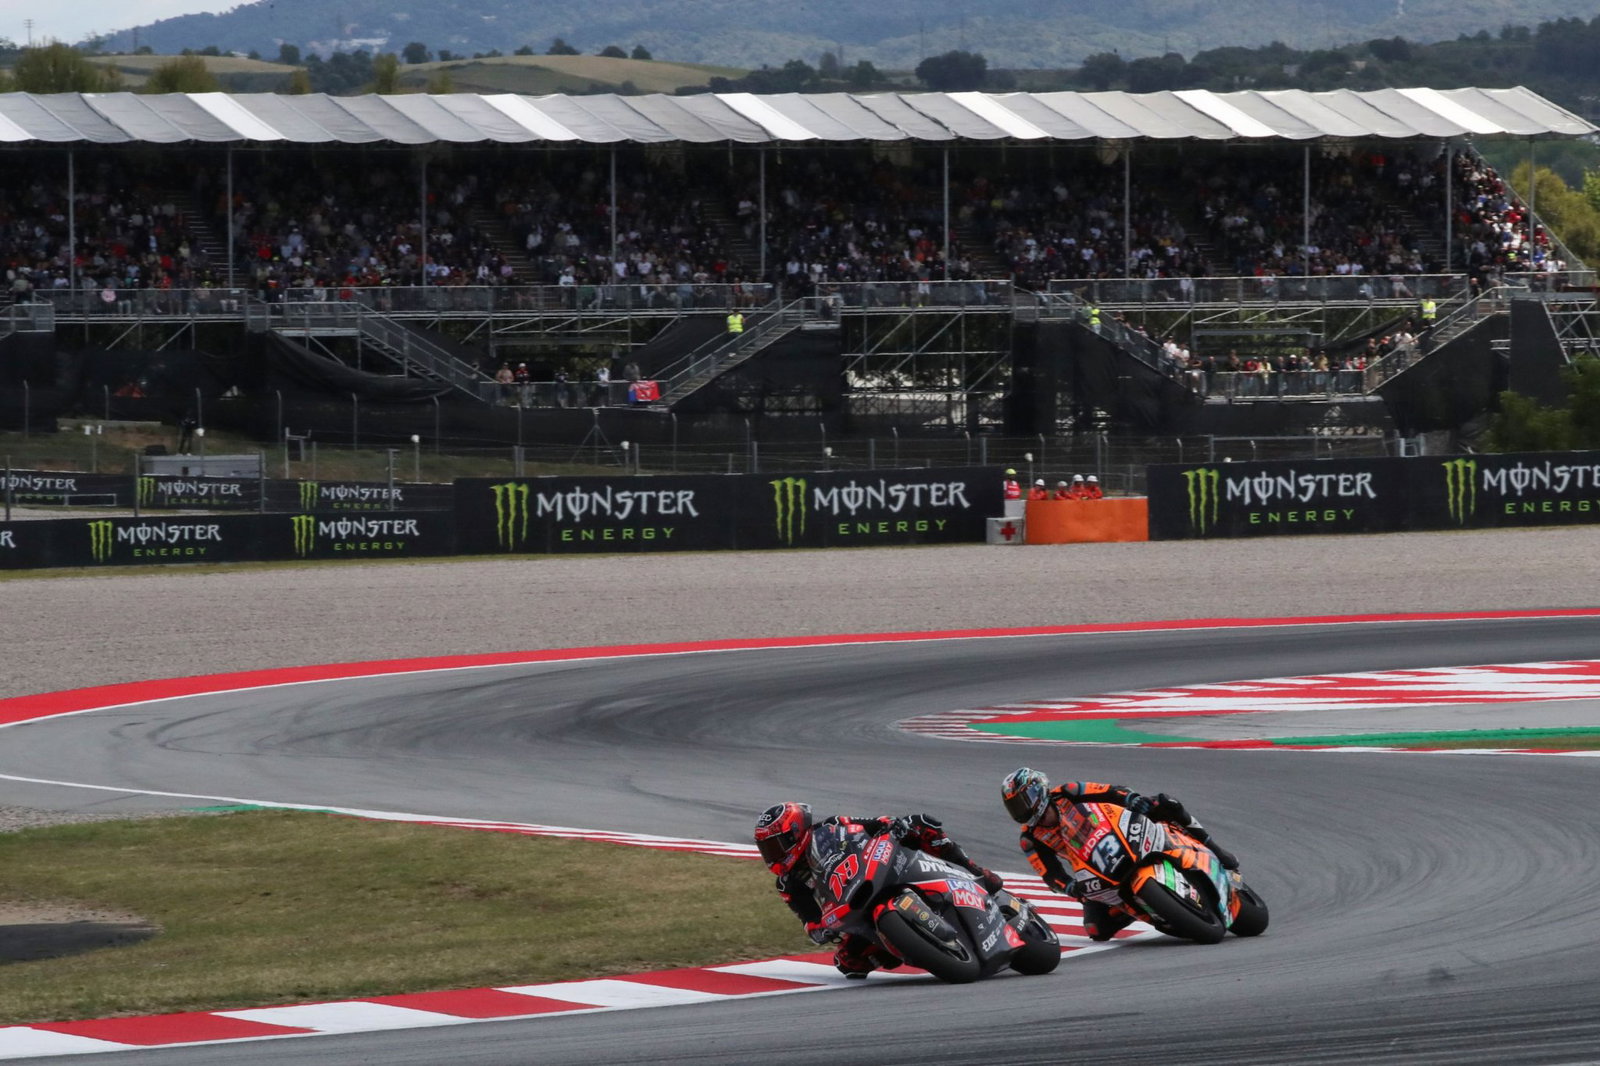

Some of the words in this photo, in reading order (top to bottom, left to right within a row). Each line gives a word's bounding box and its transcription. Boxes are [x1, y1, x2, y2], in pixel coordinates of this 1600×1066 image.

[157, 480, 242, 496] MONSTER
[320, 485, 404, 500] MONSTER
[1226, 470, 1377, 506] MONSTER
[536, 485, 699, 522] MONSTER
[812, 479, 971, 516] MONSTER
[1505, 500, 1600, 514] ENERG
[1250, 509, 1354, 524] ENERGY
[117, 522, 222, 545] MONSTER
[320, 517, 420, 539] MONSTER
[561, 527, 674, 541] ENERGY
[838, 519, 947, 535] ENERGY
[133, 547, 206, 557] ENERGY
[334, 541, 405, 551] ENERGY
[1092, 834, 1121, 873] 13
[954, 889, 985, 911] MOLY
